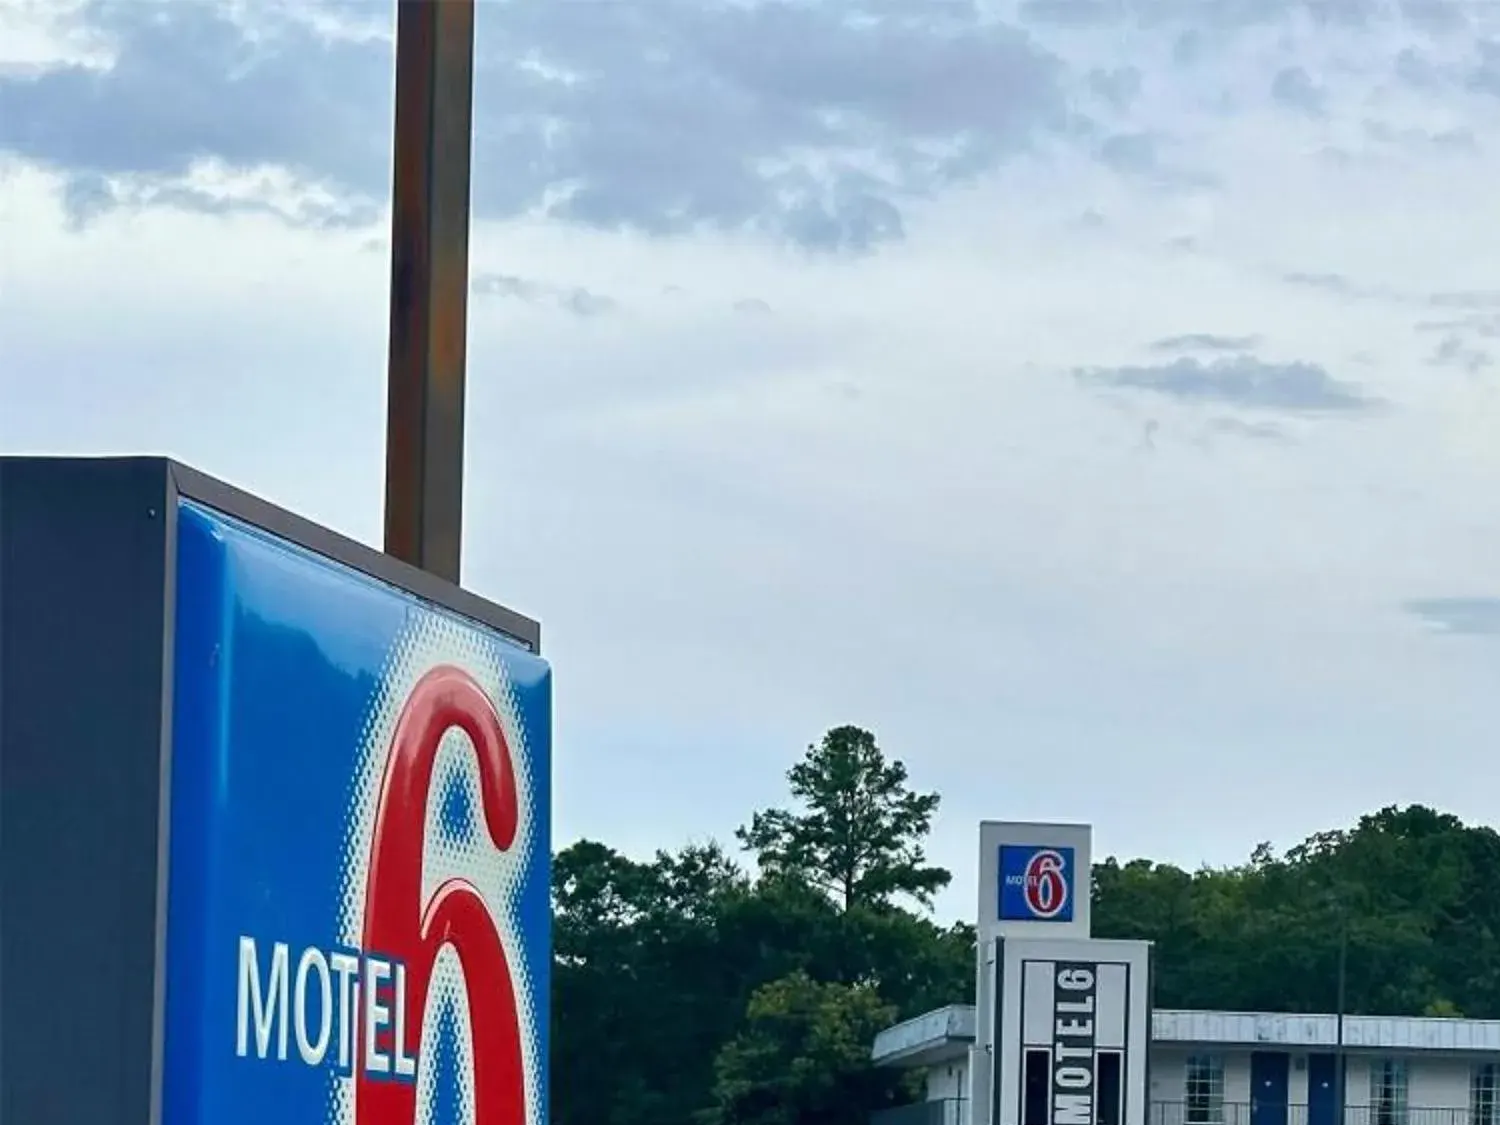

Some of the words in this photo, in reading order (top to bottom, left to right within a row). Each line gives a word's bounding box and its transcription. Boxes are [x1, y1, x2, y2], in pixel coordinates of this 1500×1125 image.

[1025, 850, 1066, 918] 6
[236, 935, 416, 1076] MOTEL
[1057, 969, 1094, 990] 6
[1054, 995, 1093, 1125] MOTEL
